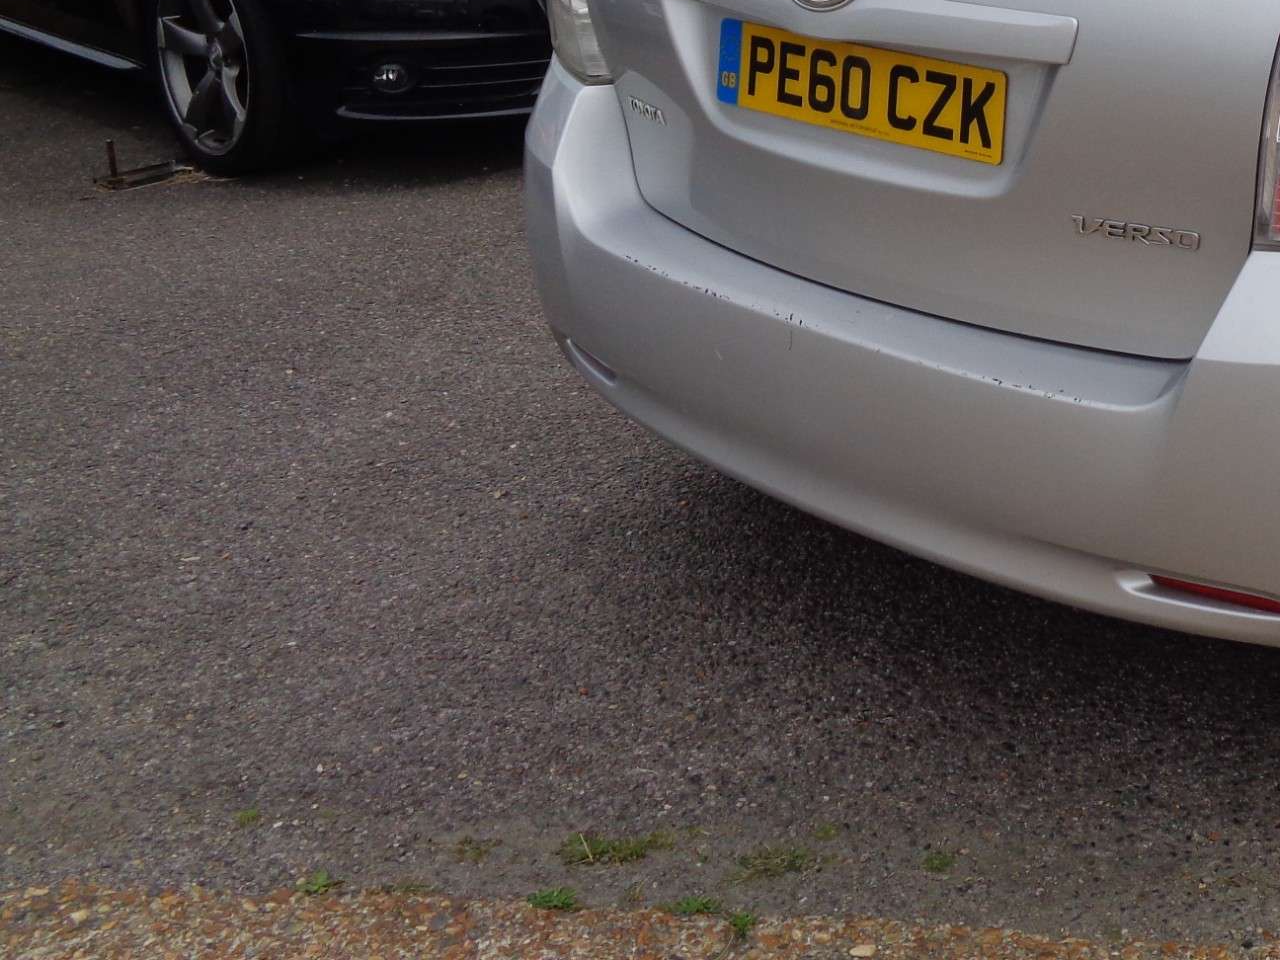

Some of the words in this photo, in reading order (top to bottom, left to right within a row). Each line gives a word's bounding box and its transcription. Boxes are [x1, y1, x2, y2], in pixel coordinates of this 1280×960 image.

[720, 71, 737, 88] GB
[747, 35, 872, 121] PE60
[887, 64, 996, 149] CZK
[1071, 214, 1201, 251] VERSO
